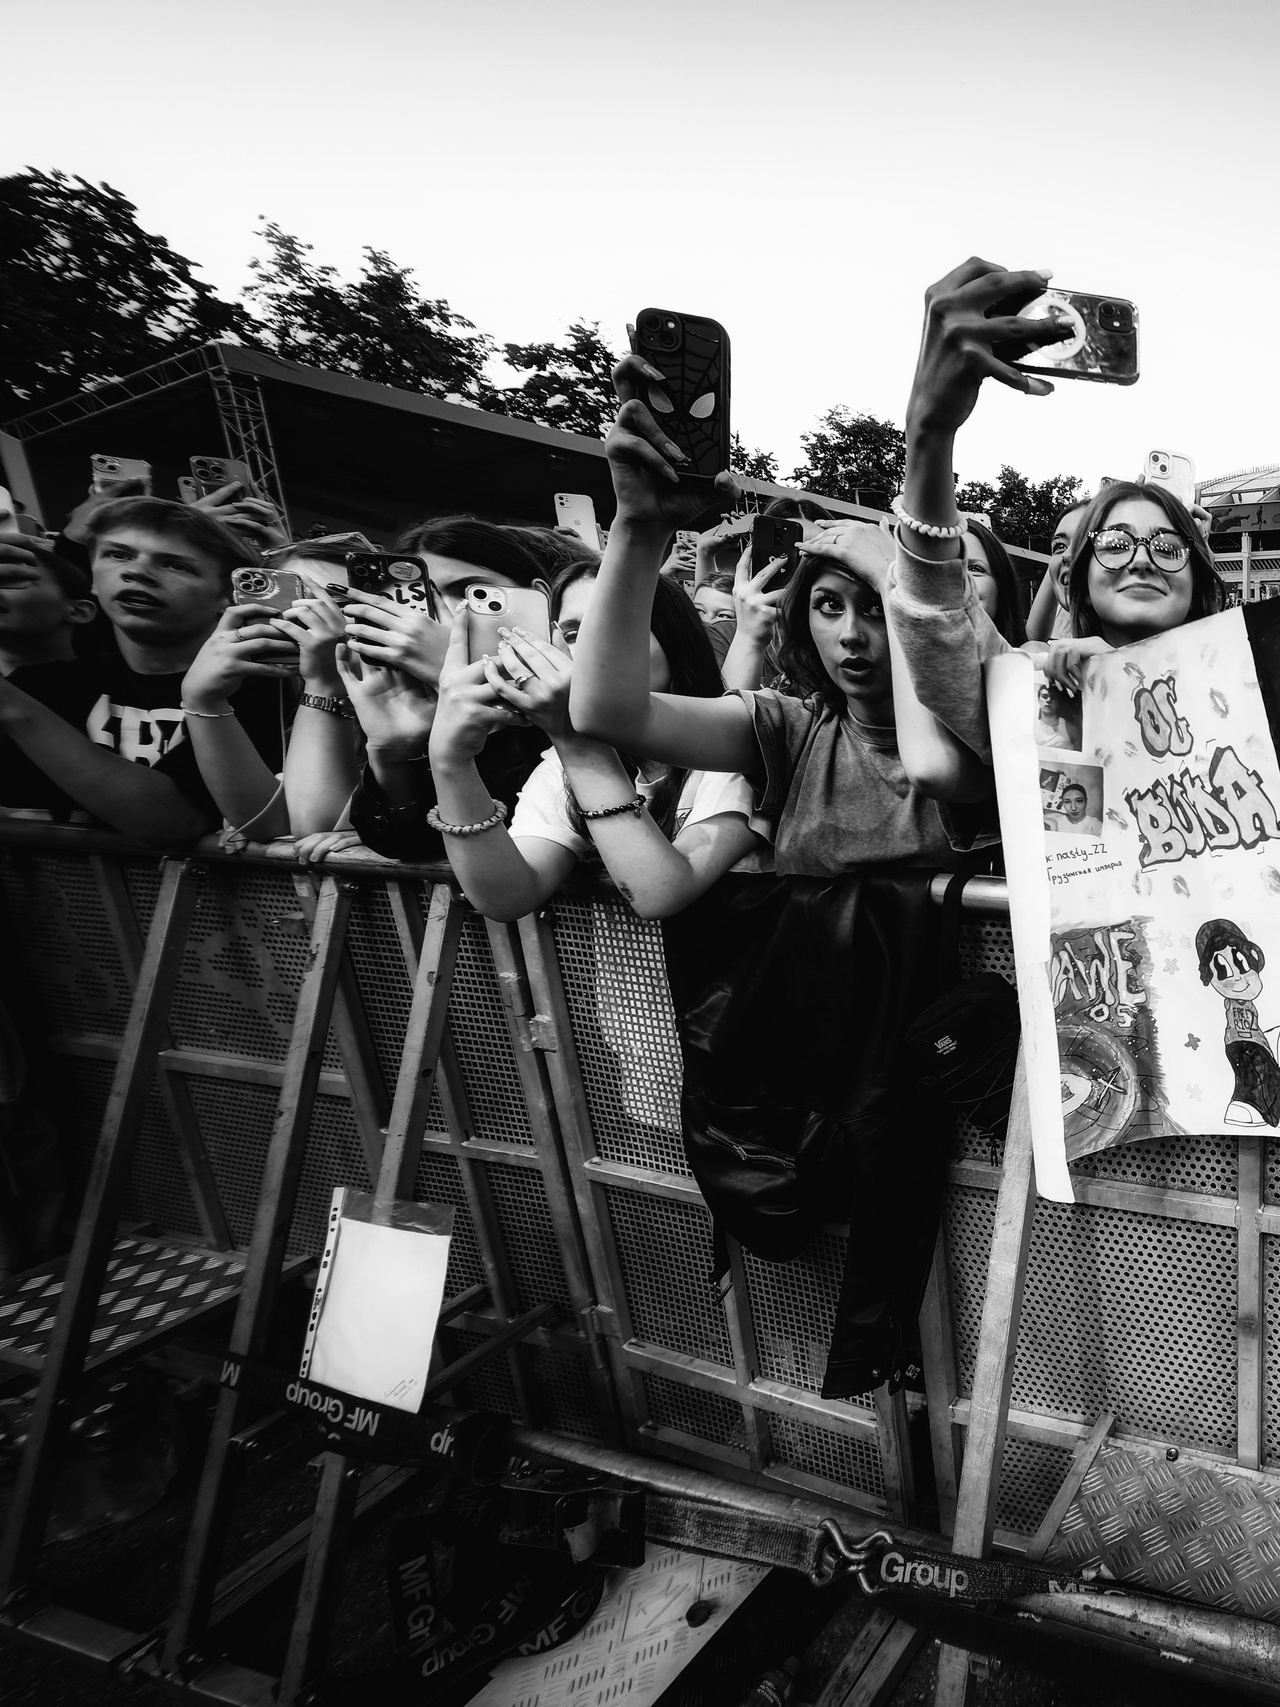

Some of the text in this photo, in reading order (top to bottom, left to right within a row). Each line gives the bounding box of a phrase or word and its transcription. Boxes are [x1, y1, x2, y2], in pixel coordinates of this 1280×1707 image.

[1047, 860, 1123, 885] Грузинская империя
[285, 1382, 344, 1423] Group
[344, 1406, 380, 1437] MF
[879, 1551, 968, 1598] Group
[518, 1613, 567, 1656] MF
